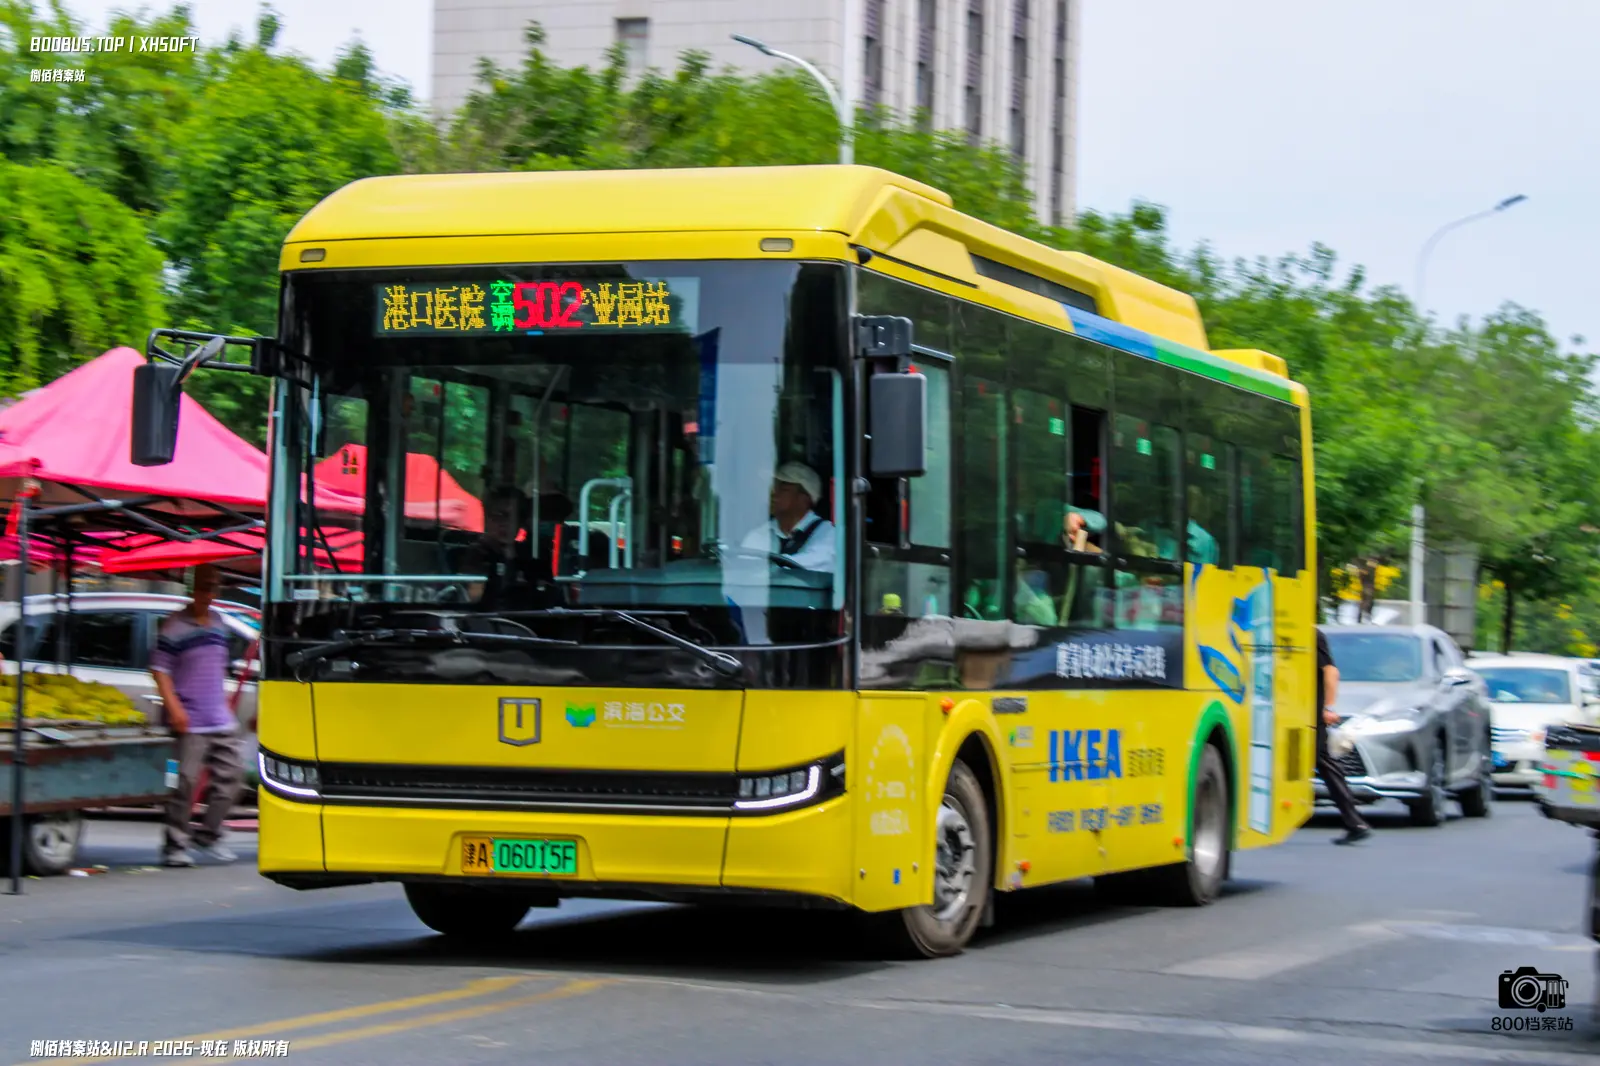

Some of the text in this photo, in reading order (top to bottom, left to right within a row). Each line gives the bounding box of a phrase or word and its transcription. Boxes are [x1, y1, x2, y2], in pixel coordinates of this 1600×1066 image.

[382, 284, 486, 331] 港口医院
[490, 279, 516, 332] 空调
[513, 280, 584, 329] 502
[603, 701, 686, 722] 滨海公交
[1049, 729, 1122, 782] IKEA
